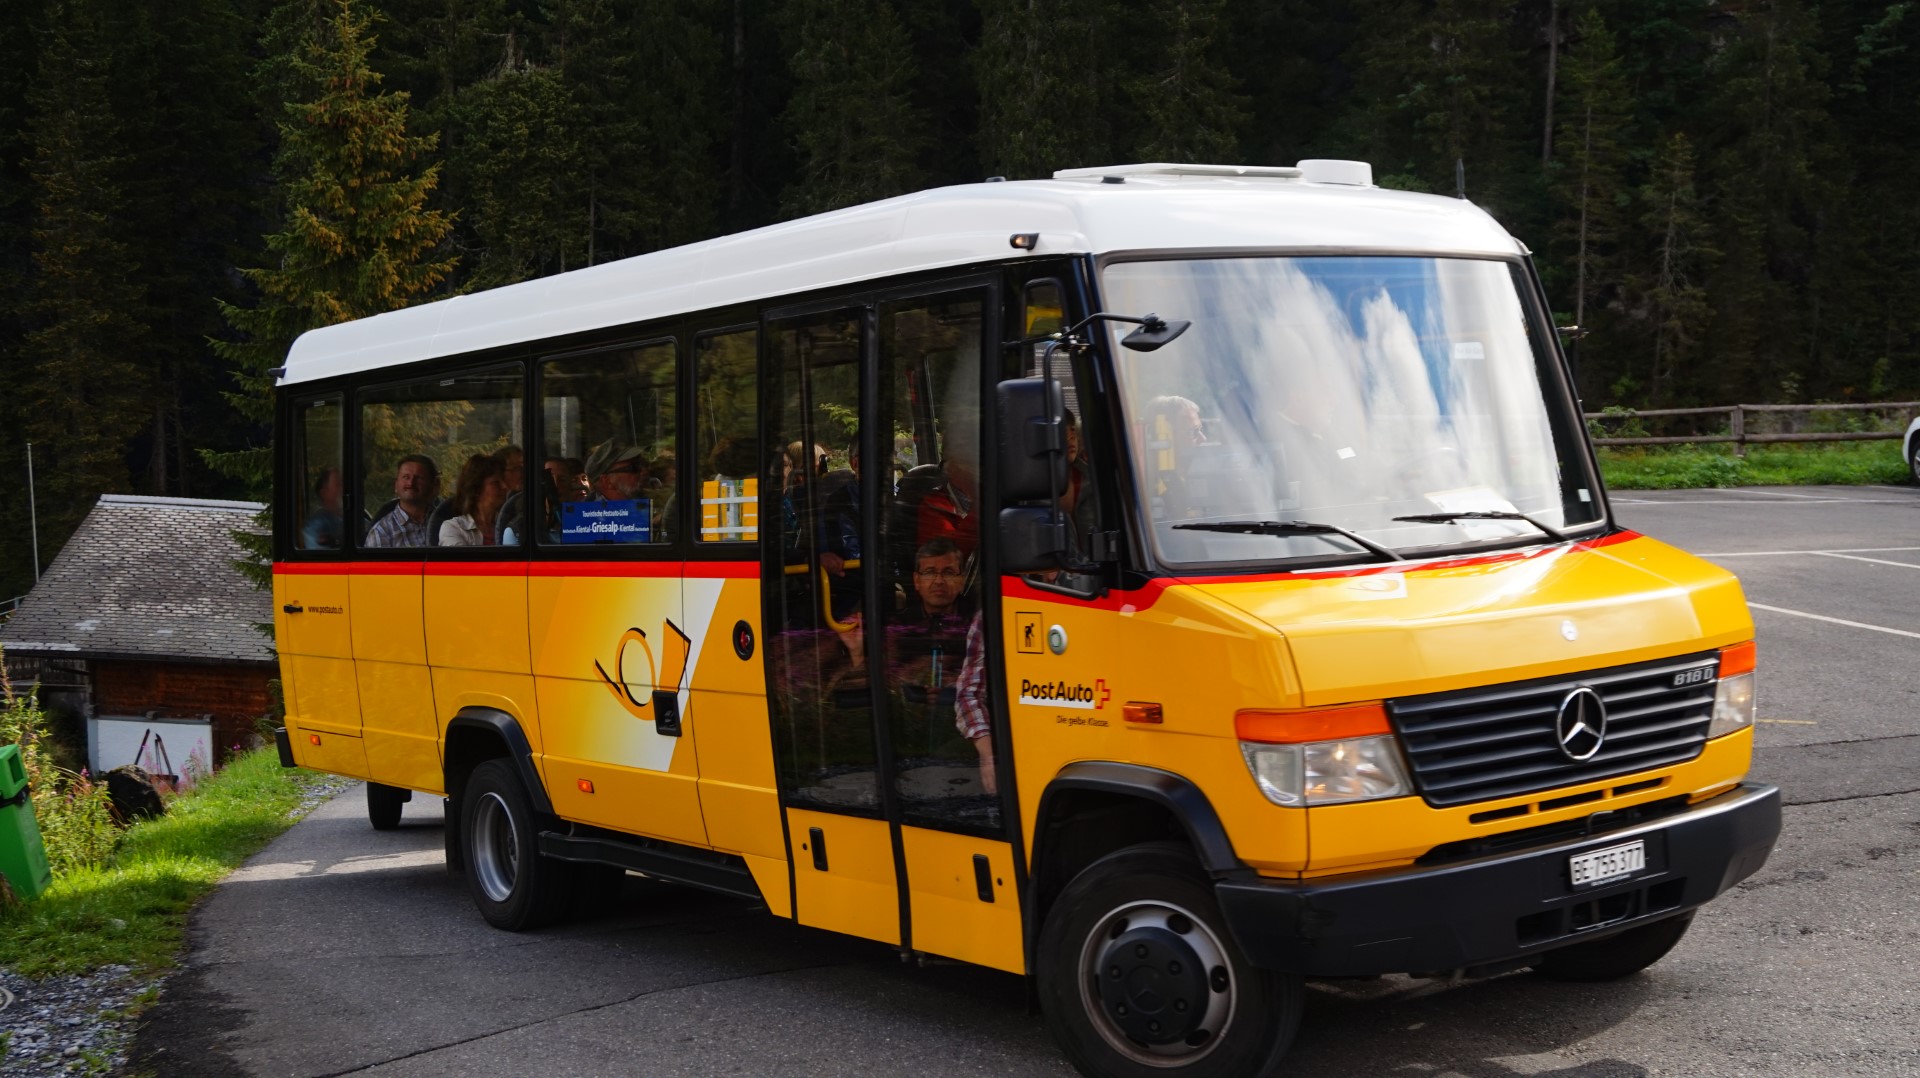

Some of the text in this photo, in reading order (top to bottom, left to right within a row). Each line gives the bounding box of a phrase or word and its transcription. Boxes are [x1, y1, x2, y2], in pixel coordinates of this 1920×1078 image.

[1673, 667, 1714, 686] 818 D
[1021, 678, 1094, 703] PostAuto
